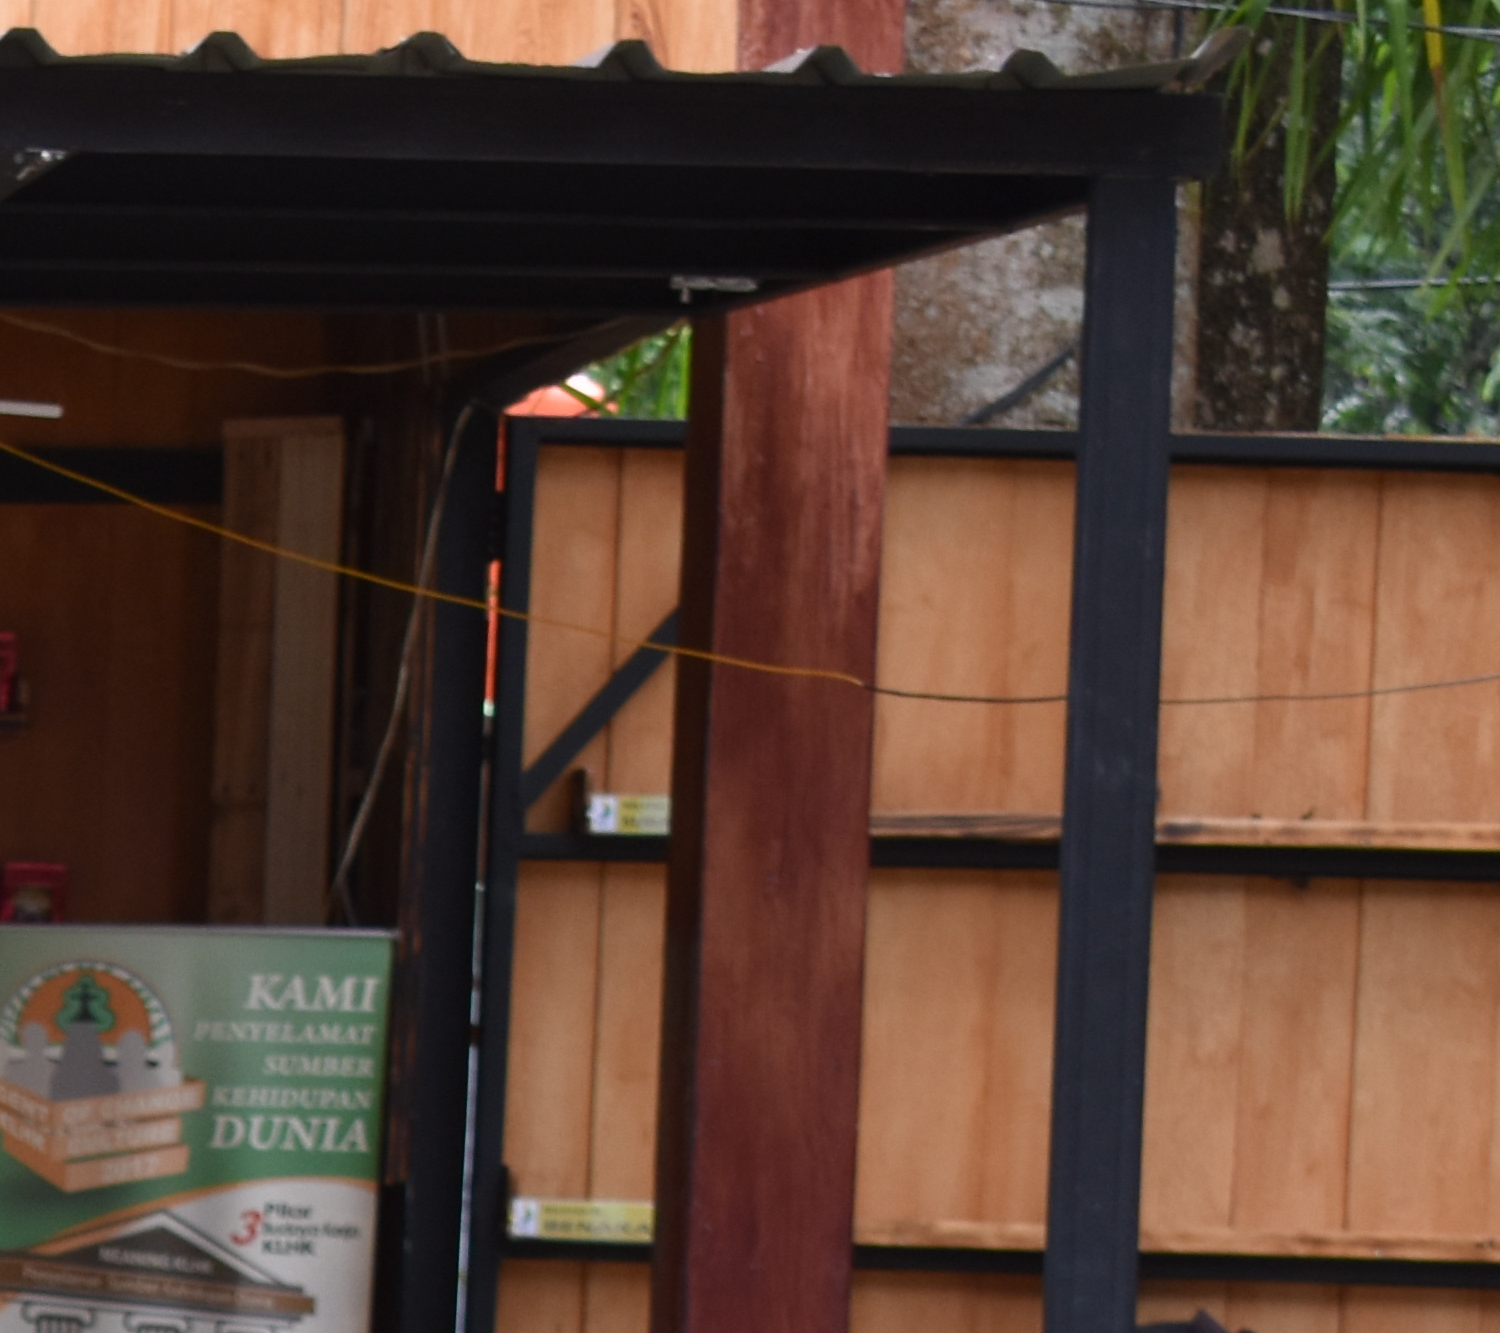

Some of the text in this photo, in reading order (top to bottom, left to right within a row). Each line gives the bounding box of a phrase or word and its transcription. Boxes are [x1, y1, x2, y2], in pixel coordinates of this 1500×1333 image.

[242, 974, 381, 1013] KAMI
[193, 1020, 378, 1046] PENYELAMAT
[262, 1054, 376, 1078] SUMBER
[212, 1085, 373, 1110] KEHIDUPAN
[209, 1115, 370, 1153] DUNIA
[230, 1209, 262, 1246] 3
